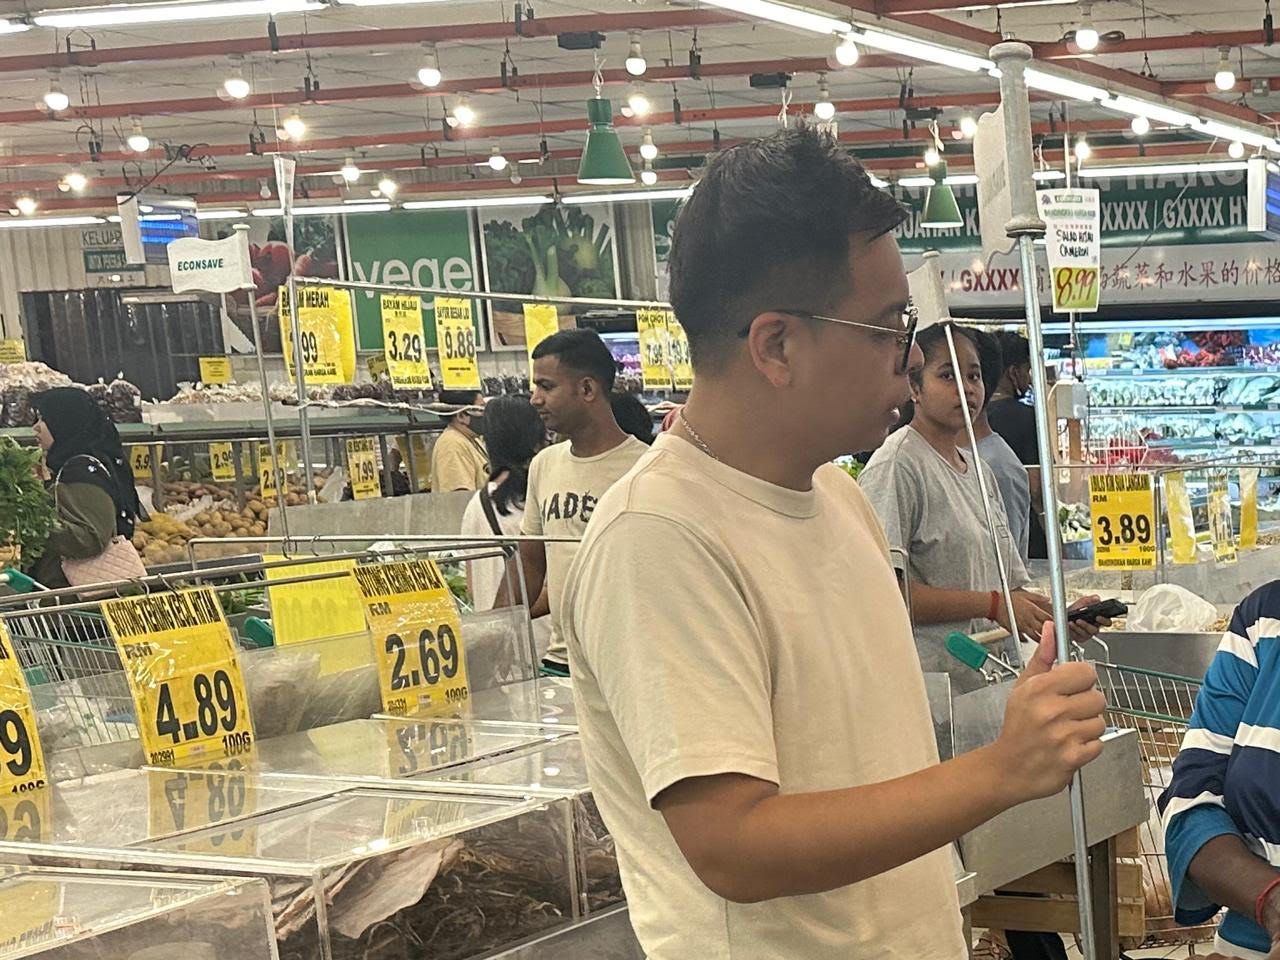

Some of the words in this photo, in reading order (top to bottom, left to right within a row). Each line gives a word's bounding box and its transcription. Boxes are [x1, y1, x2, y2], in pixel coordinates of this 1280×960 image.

[1163, 197, 1225, 228] GXXXX
[177, 258, 224, 271] ECONSAVE
[960, 268, 1020, 292] GXXXX
[353, 257, 472, 309] vege
[1056, 267, 1096, 306] 8.99
[388, 330, 421, 363] 3.29
[445, 330, 475, 359] 9.88
[355, 461, 375, 482] 7.99
[1098, 514, 1150, 545] 3.89
[368, 602, 391, 616] RM
[123, 642, 153, 659] RM
[385, 624, 459, 691] 2.69
[156, 669, 237, 744] 4.89
